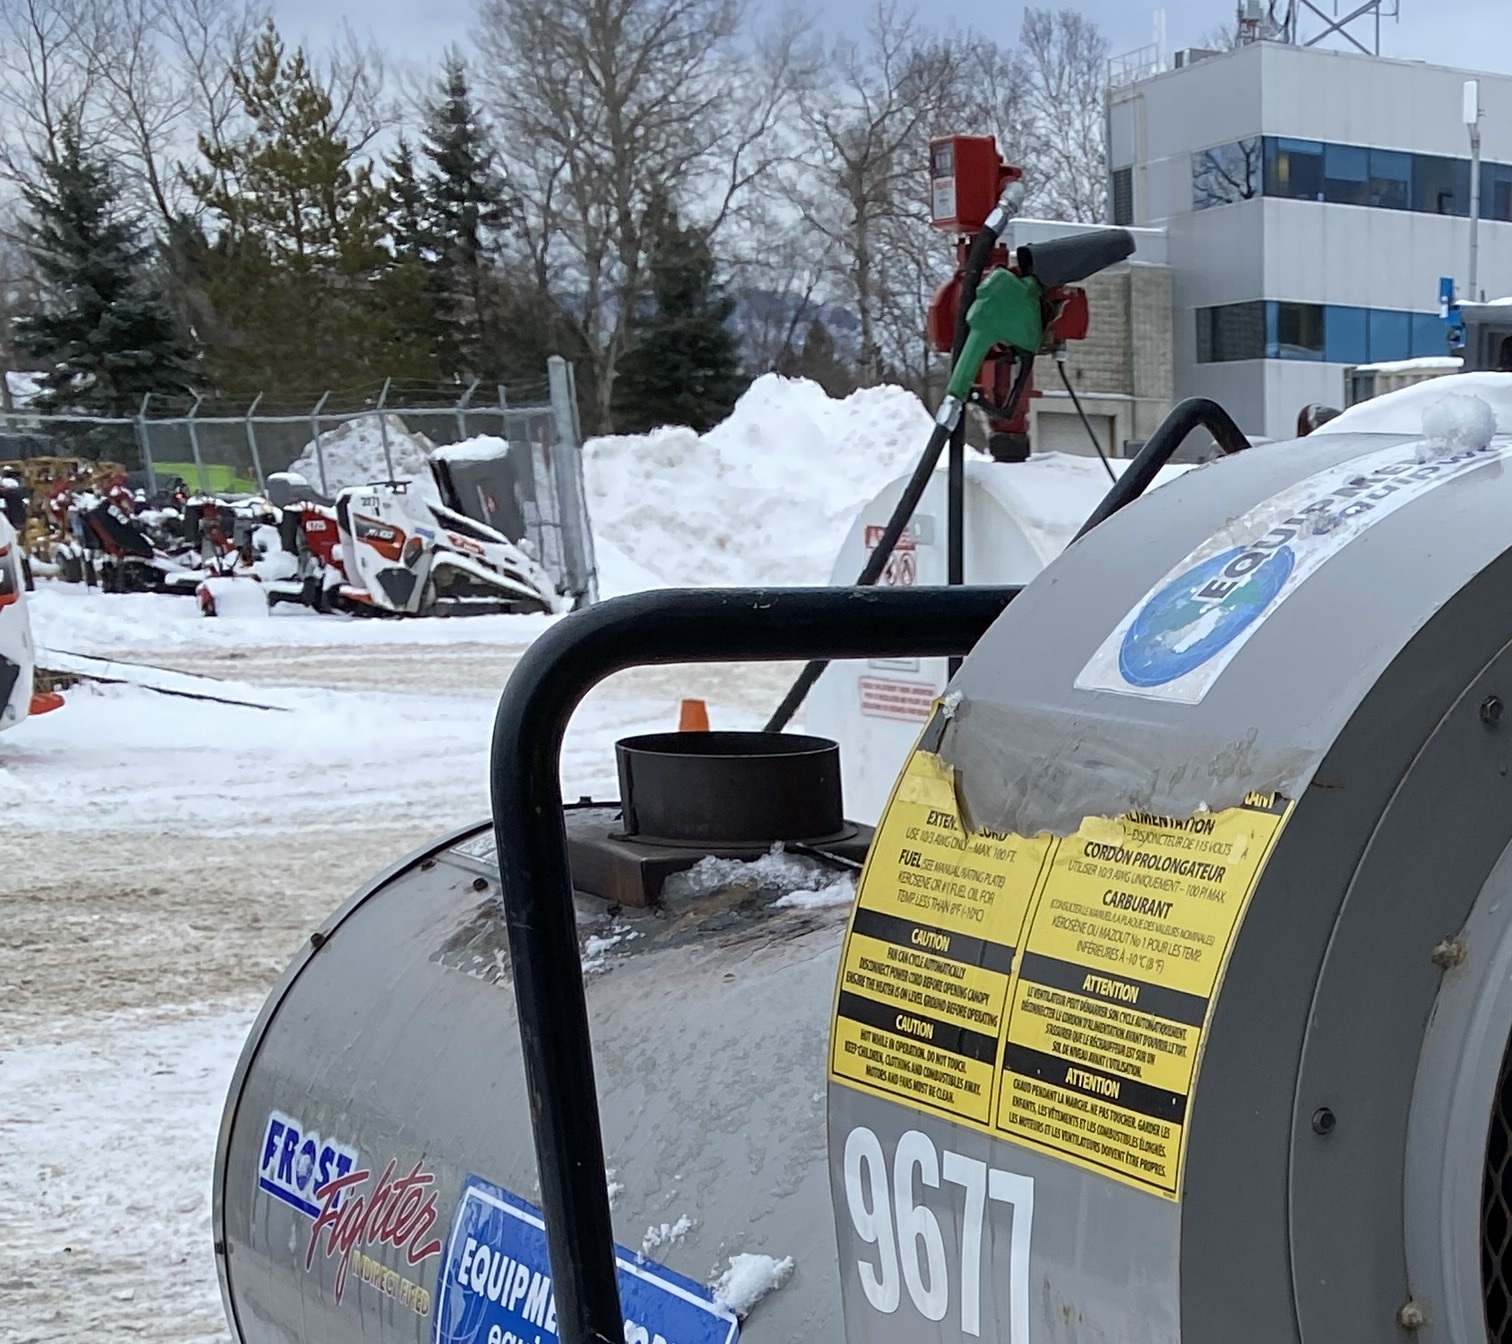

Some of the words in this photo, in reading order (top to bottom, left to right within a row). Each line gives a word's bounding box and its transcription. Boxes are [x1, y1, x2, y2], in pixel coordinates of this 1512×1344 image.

[1198, 458, 1422, 598] EQUIPME
[1126, 812, 1216, 836] LIMENTATION
[1131, 829, 1183, 847] DISJONCTEUR
[899, 849, 923, 867] FUEL
[1083, 842, 1132, 865] CORDON
[1131, 850, 1226, 883] PROLONGATEUR
[1102, 890, 1173, 919] CARBURANT
[910, 928, 950, 951] CAUTION
[1082, 974, 1139, 1003] ATTENTION
[895, 1015, 933, 1039] CAUTION
[1064, 1068, 1120, 1099] ATTENTION
[263, 1119, 353, 1209] FROST
[307, 1159, 441, 1305] Fighter
[352, 1250, 400, 1299] INDIRECT
[400, 1276, 431, 1316] FIRED
[458, 1237, 560, 1336] EQUIPME
